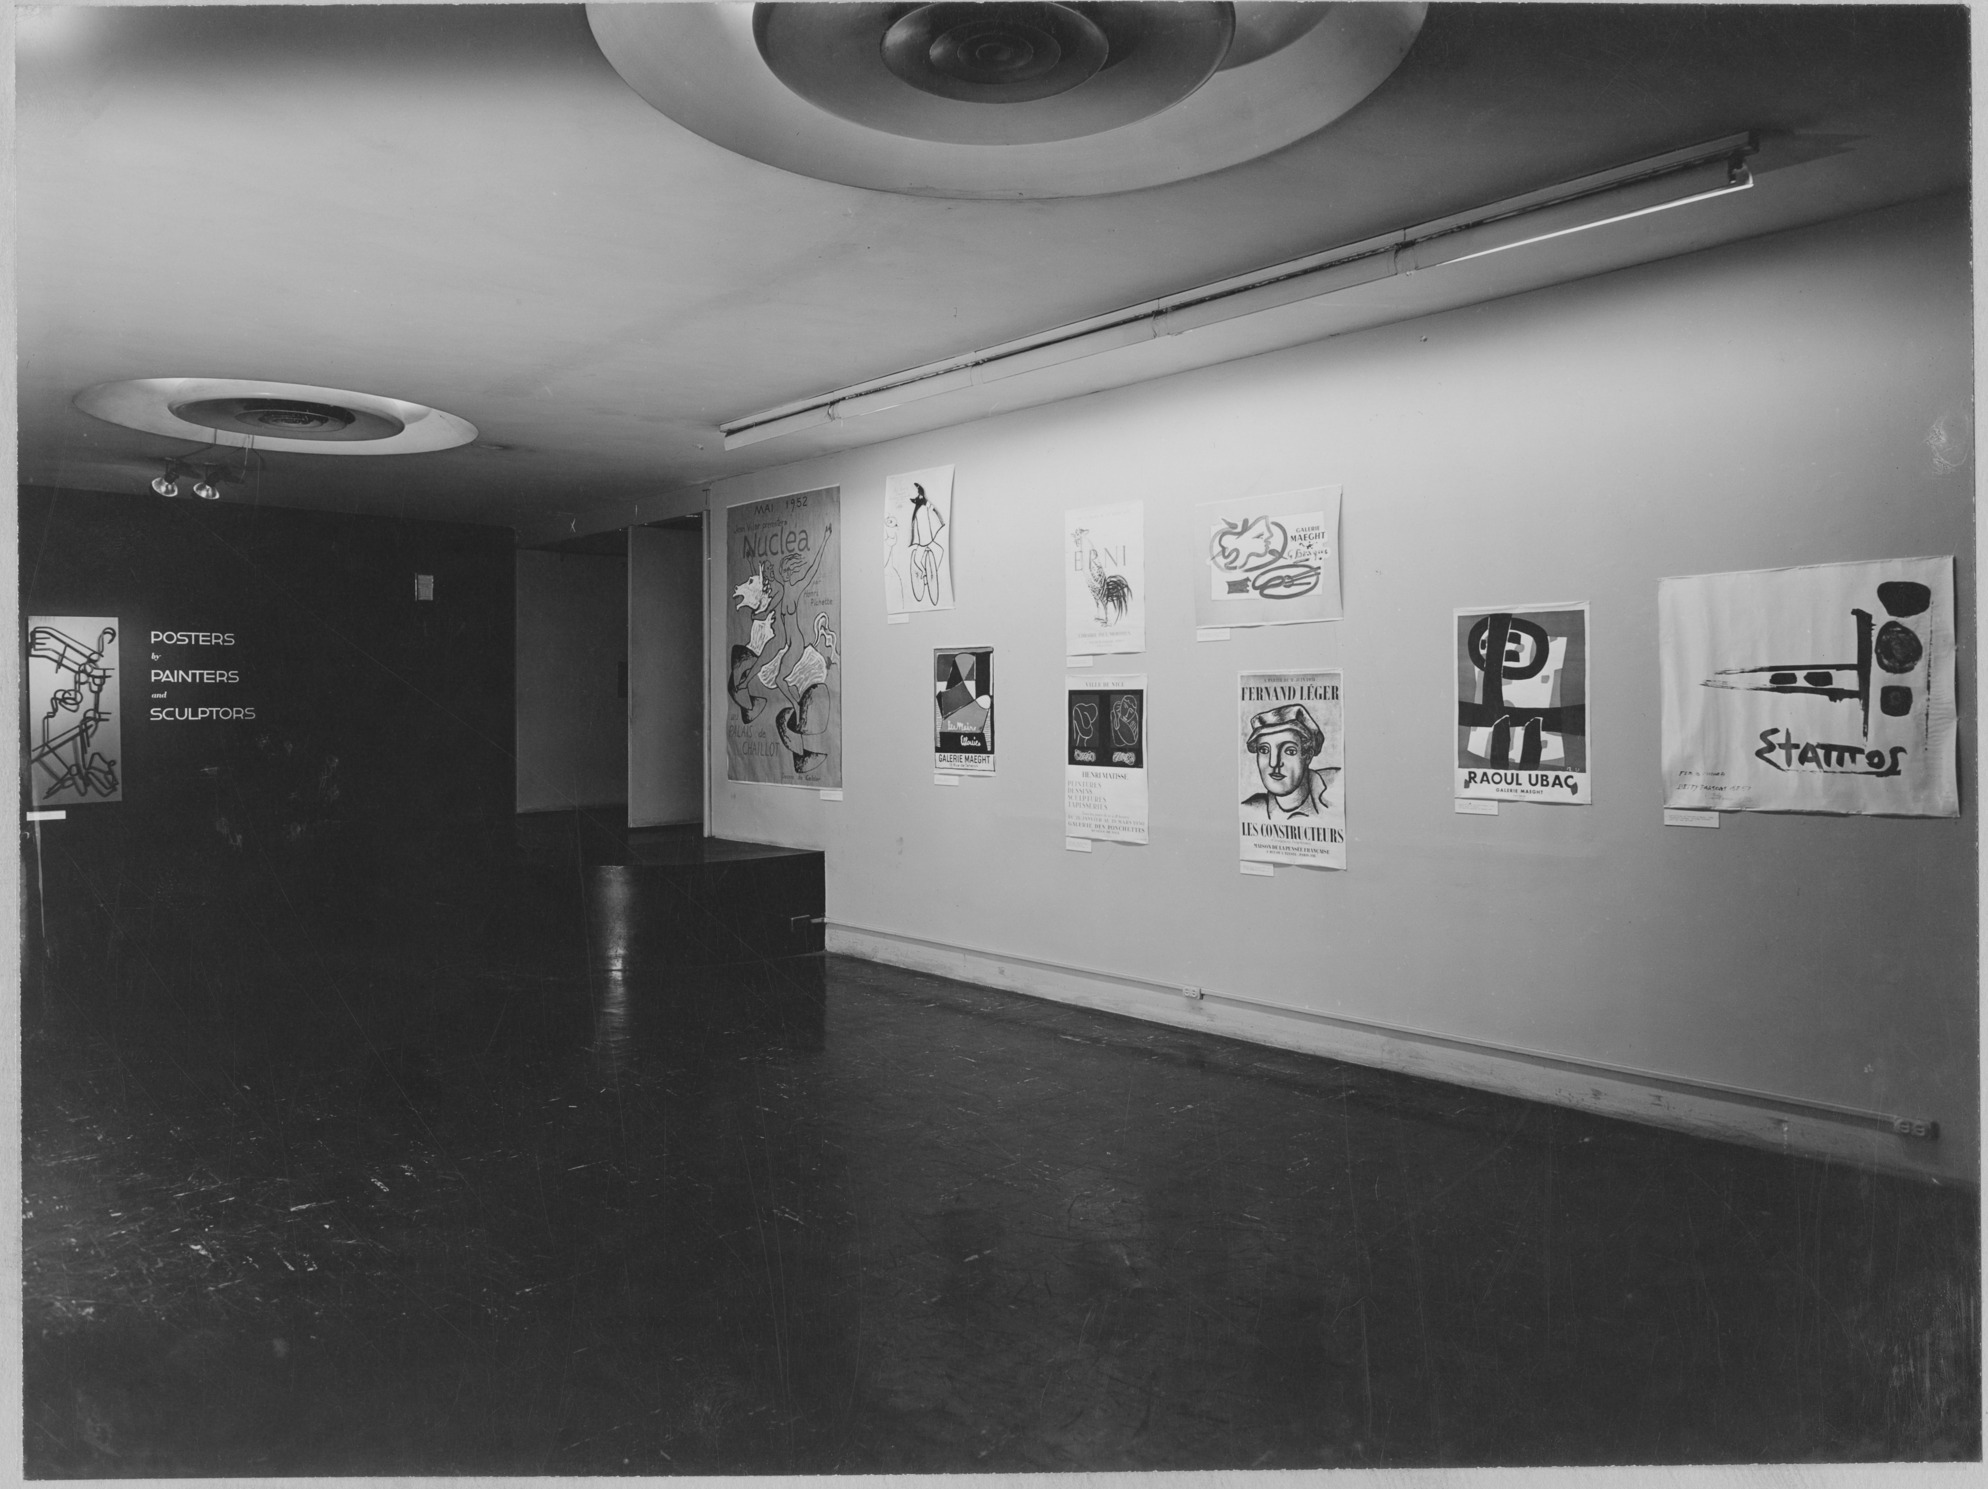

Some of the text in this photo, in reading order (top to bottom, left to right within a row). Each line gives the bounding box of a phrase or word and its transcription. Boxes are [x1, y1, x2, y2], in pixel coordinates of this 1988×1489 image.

[754, 496, 808, 516] MAI 1952
[1290, 531, 1325, 542] MAEGHT
[1075, 545, 1126, 572] ERNI
[151, 631, 236, 646] POSTERS
[151, 652, 162, 662] by
[151, 669, 240, 683] PAINTERS
[151, 691, 168, 699] and
[1241, 683, 1340, 701] FERNAND LÉGER
[150, 707, 256, 721] SCULPTORS
[729, 725, 753, 739] PALAIS
[742, 741, 780, 757] CHAILLOT
[939, 754, 991, 764] GALERIE MAEGHT
[1102, 772, 1127, 780] MATISSE
[1467, 771, 1575, 789] RAOUL UBAC
[1241, 822, 1345, 844] LES CONSTRUCTEURS
